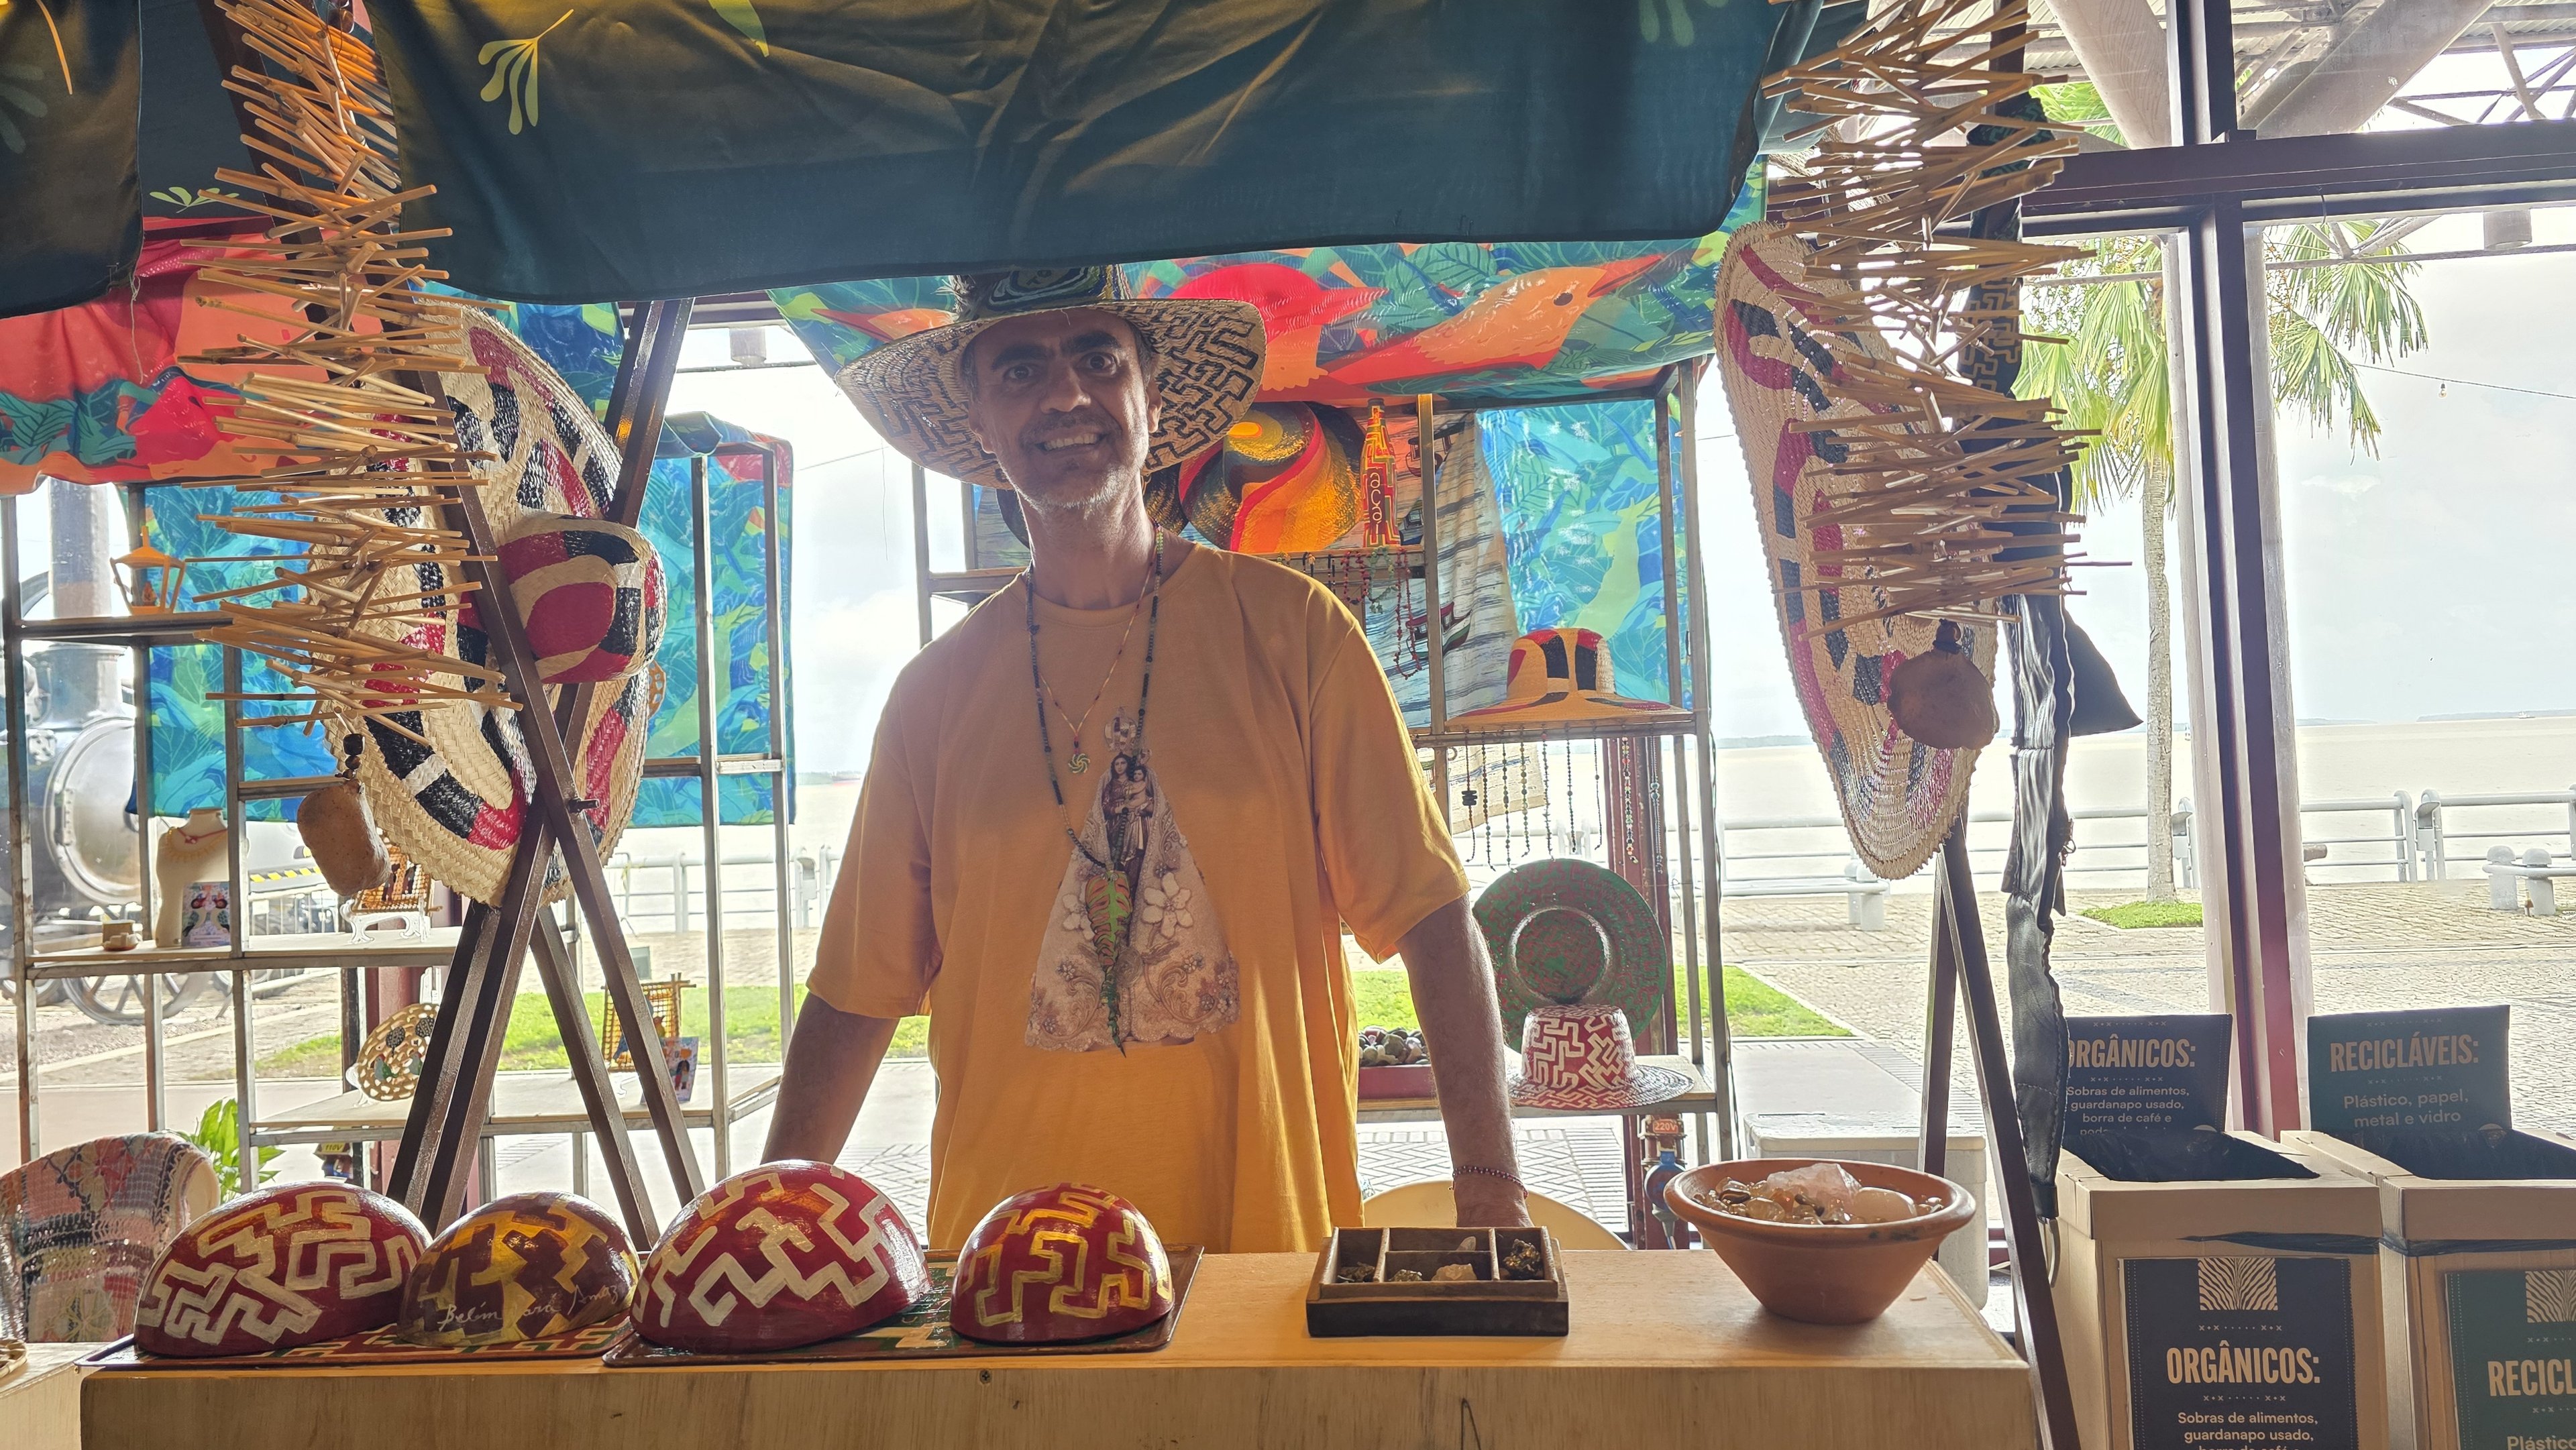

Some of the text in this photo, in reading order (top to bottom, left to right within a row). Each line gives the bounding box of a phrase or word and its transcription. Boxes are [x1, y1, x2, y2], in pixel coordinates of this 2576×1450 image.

[1369, 471, 1383, 535] açaí
[2330, 1031, 2479, 1072] RECICLÁVEIS:
[2067, 1086, 2190, 1097] Sobras de alimentos,
[2343, 1089, 2469, 1109] Plástico, papel,
[2070, 1099, 2185, 1112] guardanapo usado,
[1654, 1121, 1676, 1131] 220V
[2082, 1113, 2172, 1123] borra de café e
[2354, 1109, 2462, 1127] metal e vidro
[2080, 1126, 2110, 1135] pod
[437, 1301, 502, 1331] Belém
[2165, 1339, 2321, 1384] ORGÂNICOS:
[2487, 1358, 2576, 1397] RECICL
[2178, 1411, 2318, 1425] Sobras de alimentos,
[2184, 1429, 2314, 1444] guardanapo usado,
